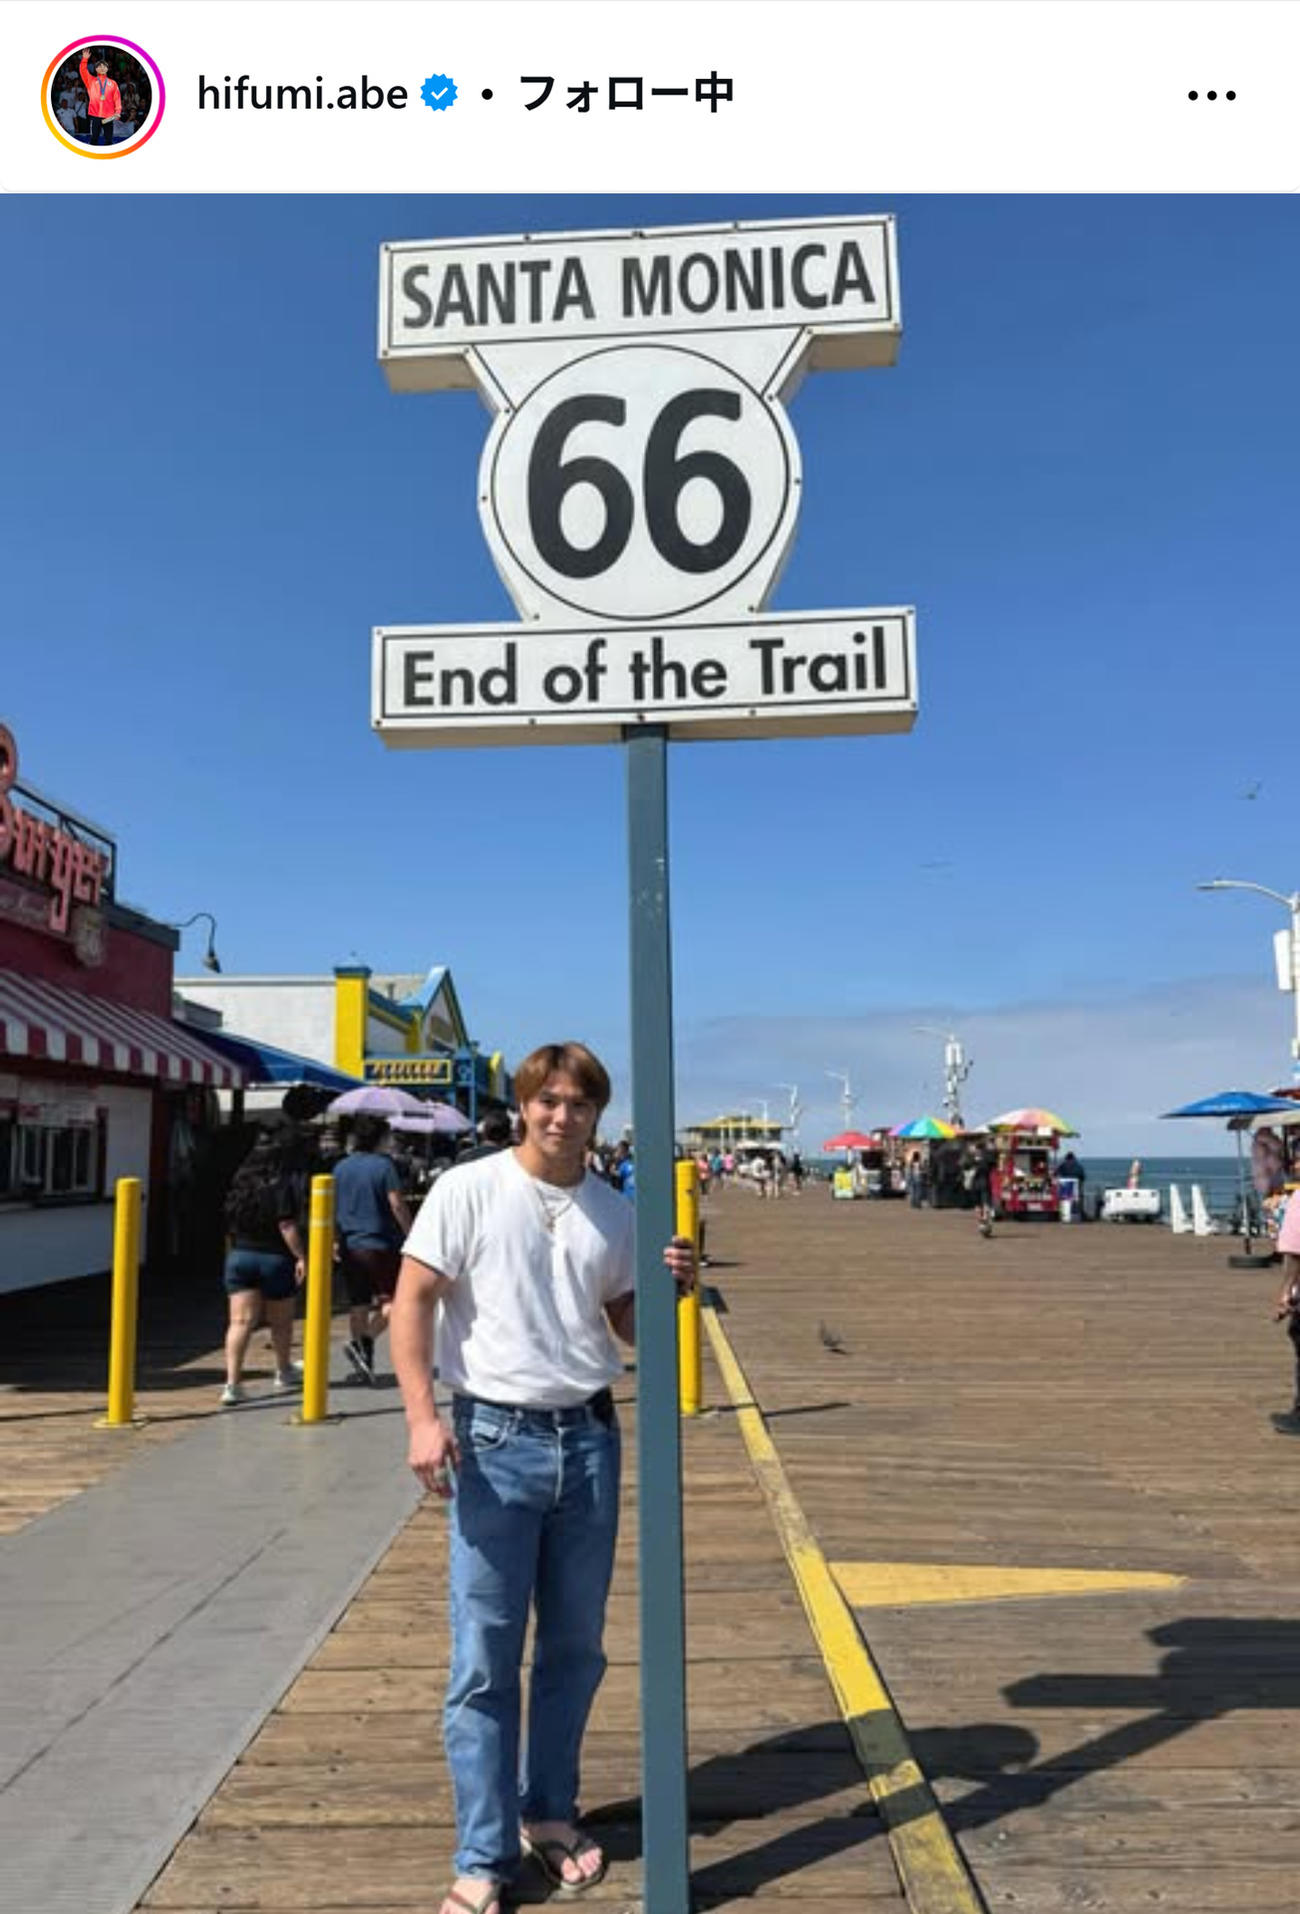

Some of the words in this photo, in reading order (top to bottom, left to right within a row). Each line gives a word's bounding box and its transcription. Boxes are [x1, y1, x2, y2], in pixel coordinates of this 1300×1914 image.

[403, 256, 596, 329] SANTA
[622, 241, 876, 318] MONICA
[527, 387, 752, 580] 66
[403, 642, 518, 707] End
[543, 637, 608, 704] of
[628, 636, 728, 701] the
[749, 625, 887, 695] Trail
